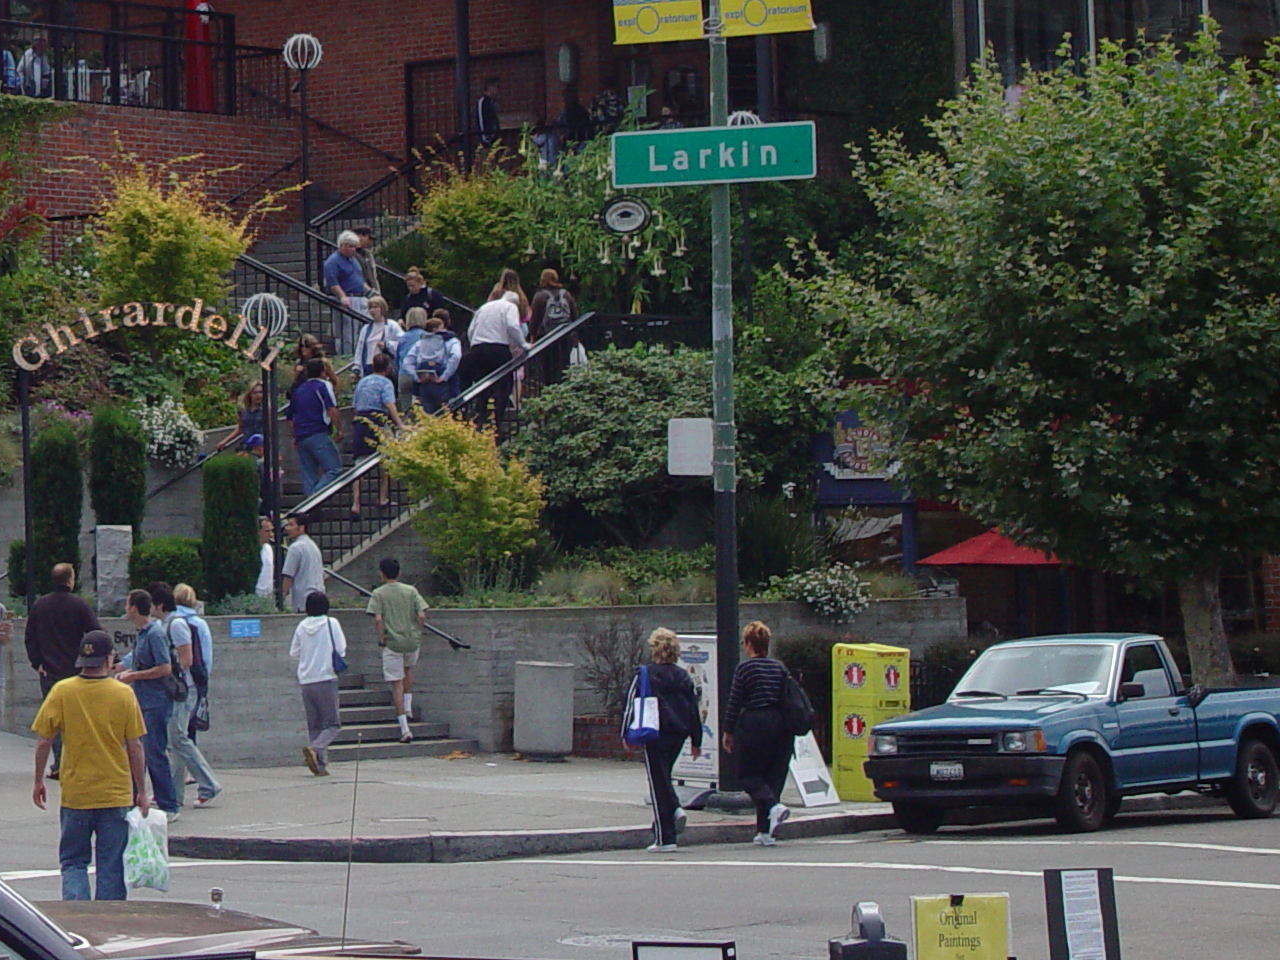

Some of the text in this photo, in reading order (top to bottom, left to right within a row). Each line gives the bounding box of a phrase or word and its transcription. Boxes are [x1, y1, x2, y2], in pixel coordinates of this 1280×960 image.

[648, 141, 778, 172] Larkin
[12, 298, 284, 372] Ghirardelli
[939, 910, 977, 929] Original
[938, 933, 981, 951] Paintings
